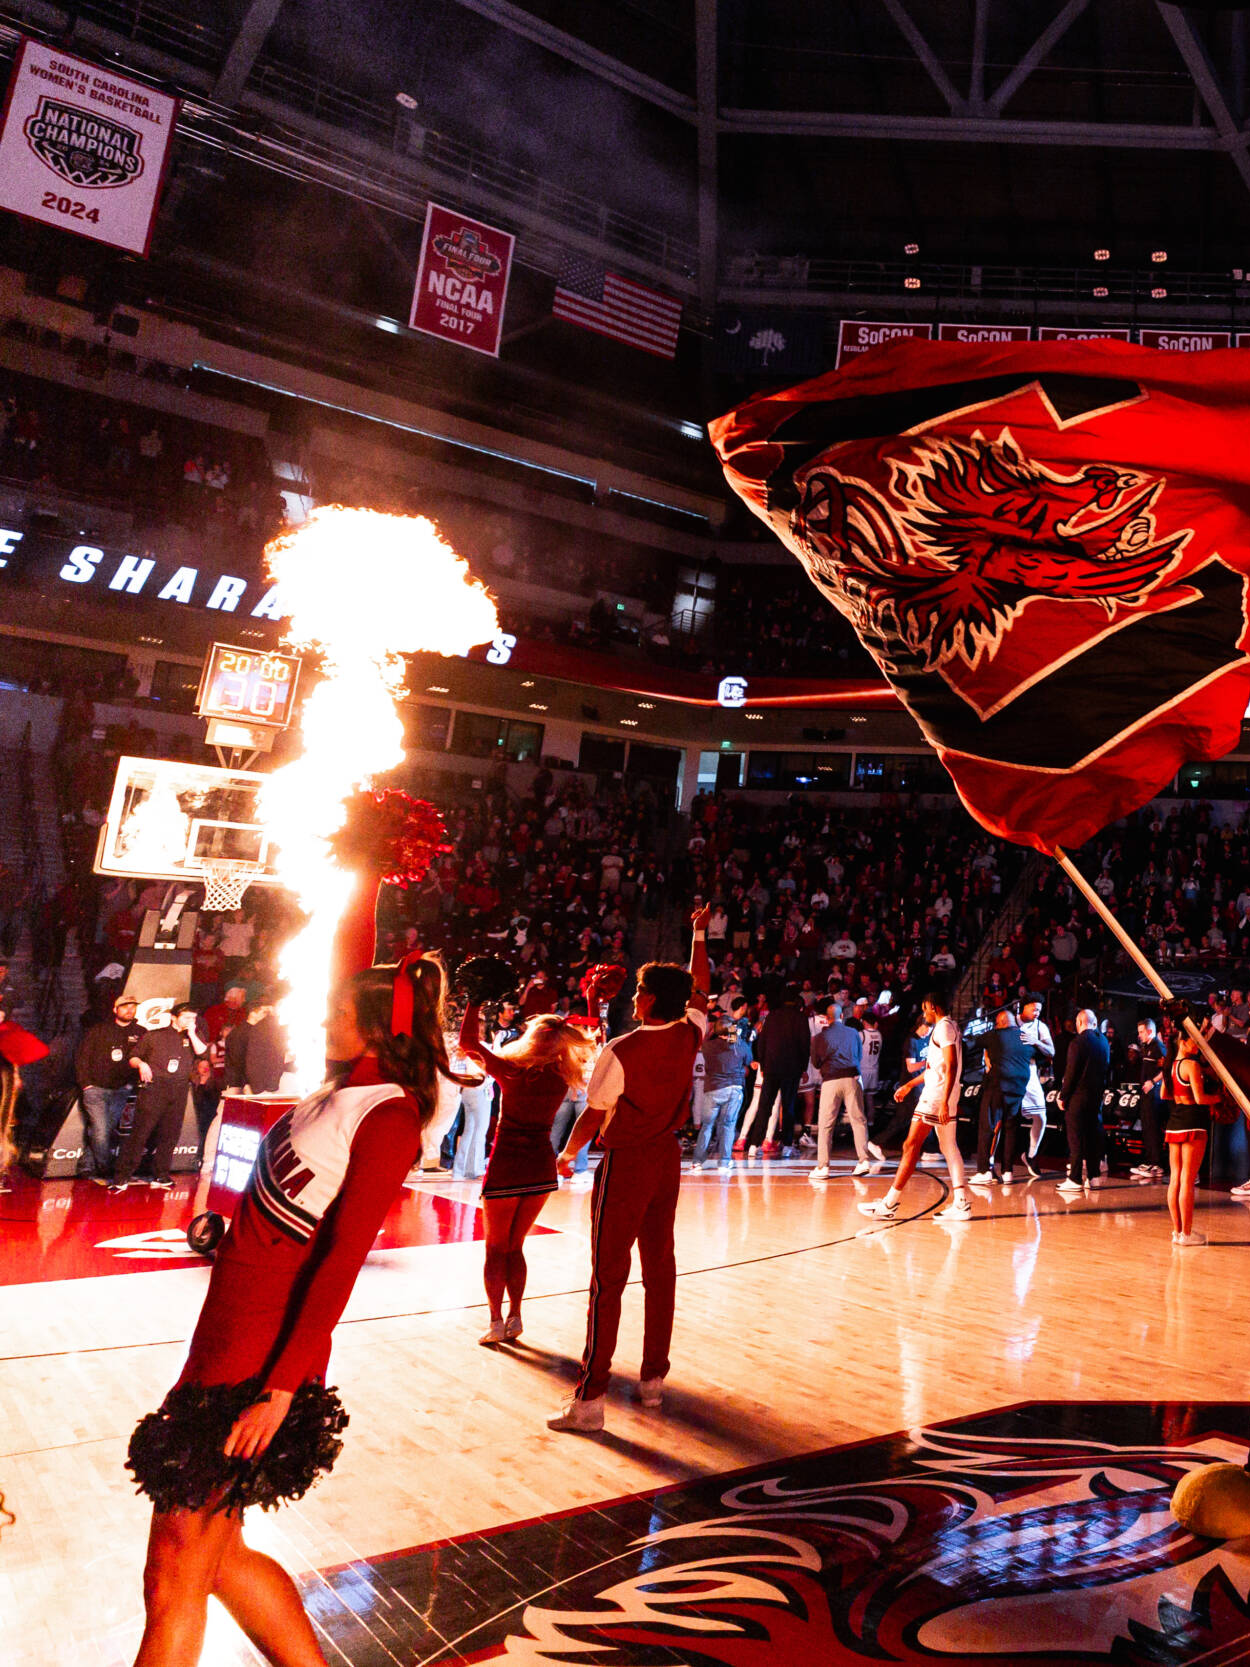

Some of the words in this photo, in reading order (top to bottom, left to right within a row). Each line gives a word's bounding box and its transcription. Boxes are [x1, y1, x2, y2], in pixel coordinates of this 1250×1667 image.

[29, 64, 85, 95] WOMEN'S
[89, 90, 162, 125] BASKETBALL
[49, 60, 90, 82] SOUTH
[93, 78, 150, 107] CAROLINA
[33, 121, 137, 173] CHAMPIONS
[44, 107, 131, 155] NATIONAL
[41, 191, 100, 224] 2024
[442, 243, 467, 257] FINAL
[468, 252, 492, 266] FOUR
[428, 270, 494, 315] NCAA
[435, 298, 458, 313] FINAL
[461, 307, 482, 322] FOUR
[440, 312, 475, 335] 2017
[59, 545, 284, 621] SHARA
[868, 1041, 880, 1055] 15
